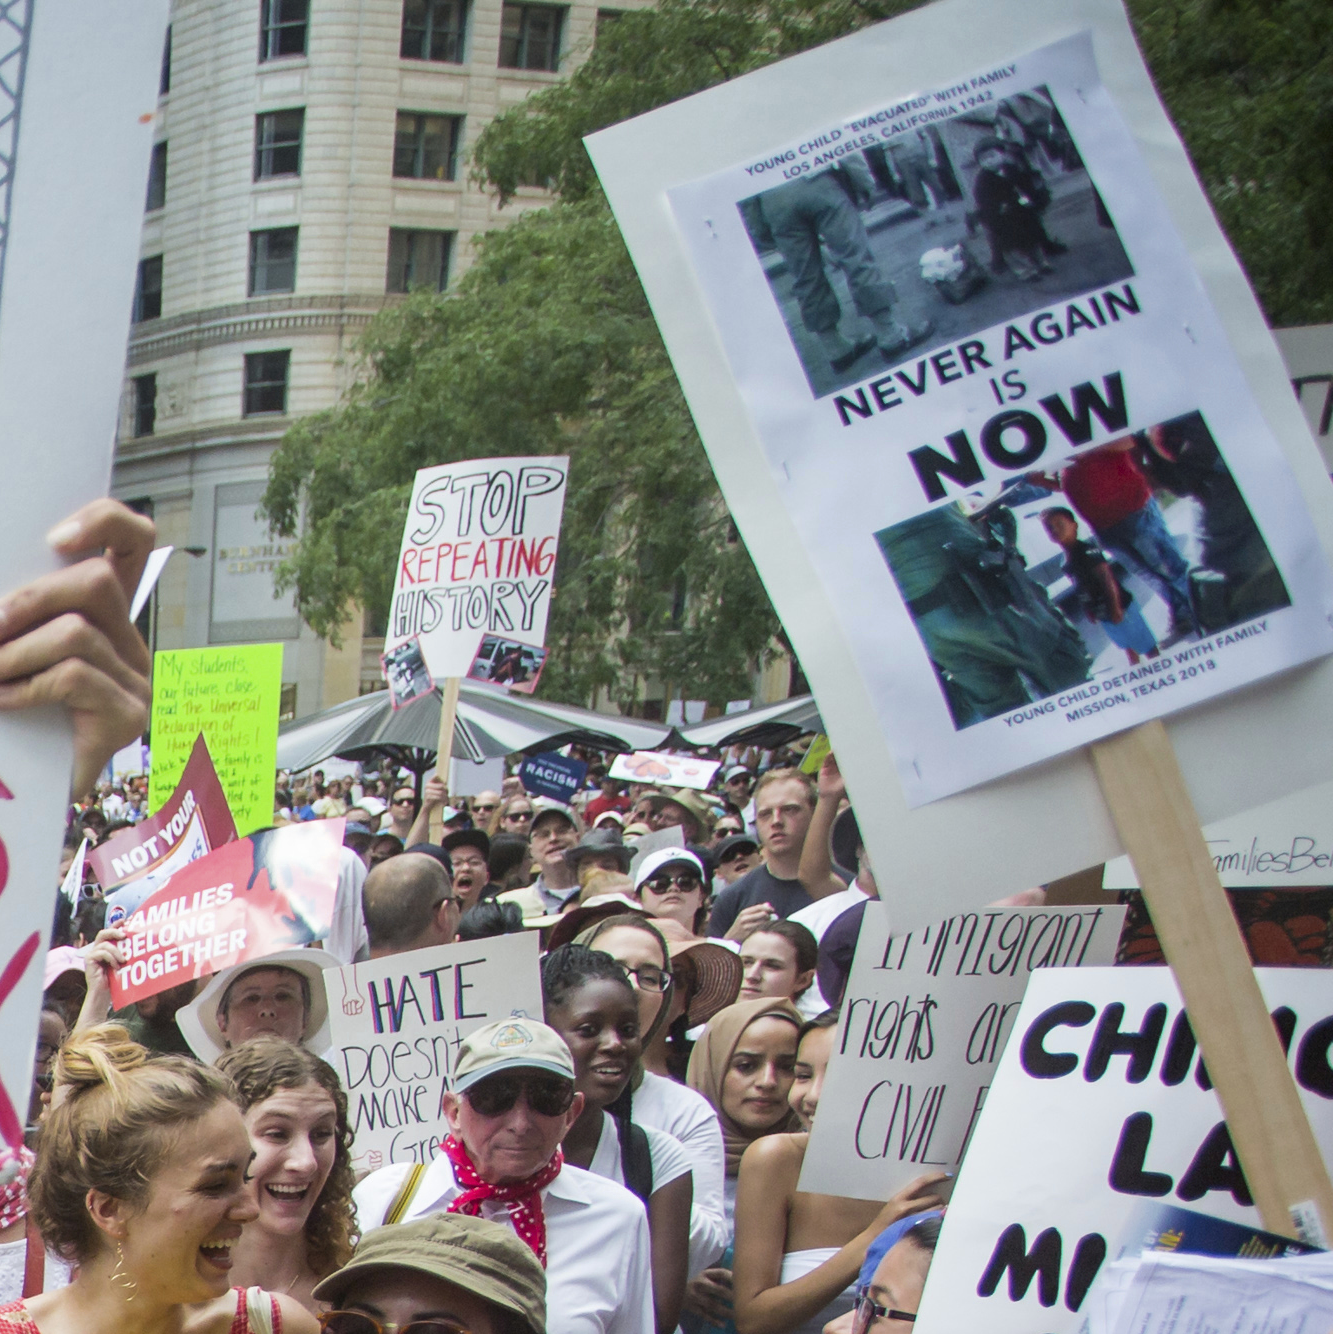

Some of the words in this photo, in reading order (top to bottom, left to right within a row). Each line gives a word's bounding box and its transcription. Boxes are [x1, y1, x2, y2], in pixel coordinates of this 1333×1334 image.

[745, 151, 796, 177] YOUNG
[798, 129, 842, 156] CHILD
[933, 84, 969, 104] WITH
[970, 64, 1017, 89] FAMILY
[782, 162, 810, 180] LOS
[813, 132, 880, 168] ANGELES,
[880, 105, 958, 139] CALIFORNIA
[959, 90, 993, 110] 1942
[832, 337, 992, 427] NEVER
[1002, 282, 1142, 361] AGAIN
[989, 368, 1028, 407] IS
[907, 369, 1130, 502] NOW
[410, 467, 564, 545] STOP
[401, 533, 556, 588] REPEATING
[394, 580, 549, 638] HISTORY
[211, 695, 261, 713] Universal
[1003, 700, 1056, 728] YOUNG
[1057, 685, 1101, 708] CHILD
[1102, 659, 1172, 691] DETAINED
[1174, 642, 1213, 664] WITH
[1215, 620, 1268, 650] FAMILY
[1066, 694, 1131, 724] MISSION,
[1131, 673, 1177, 699] TEXAS
[1180, 660, 1217, 682] 2018
[526, 763, 578, 789] RACISM
[111, 835, 159, 879] NOT
[158, 789, 196, 846] YOUR
[116, 928, 247, 991] TOGETHER
[117, 912, 215, 961] BELONG
[368, 958, 487, 1034] HATE
[841, 994, 939, 1064] rights
[855, 1080, 948, 1165] CIVIL
